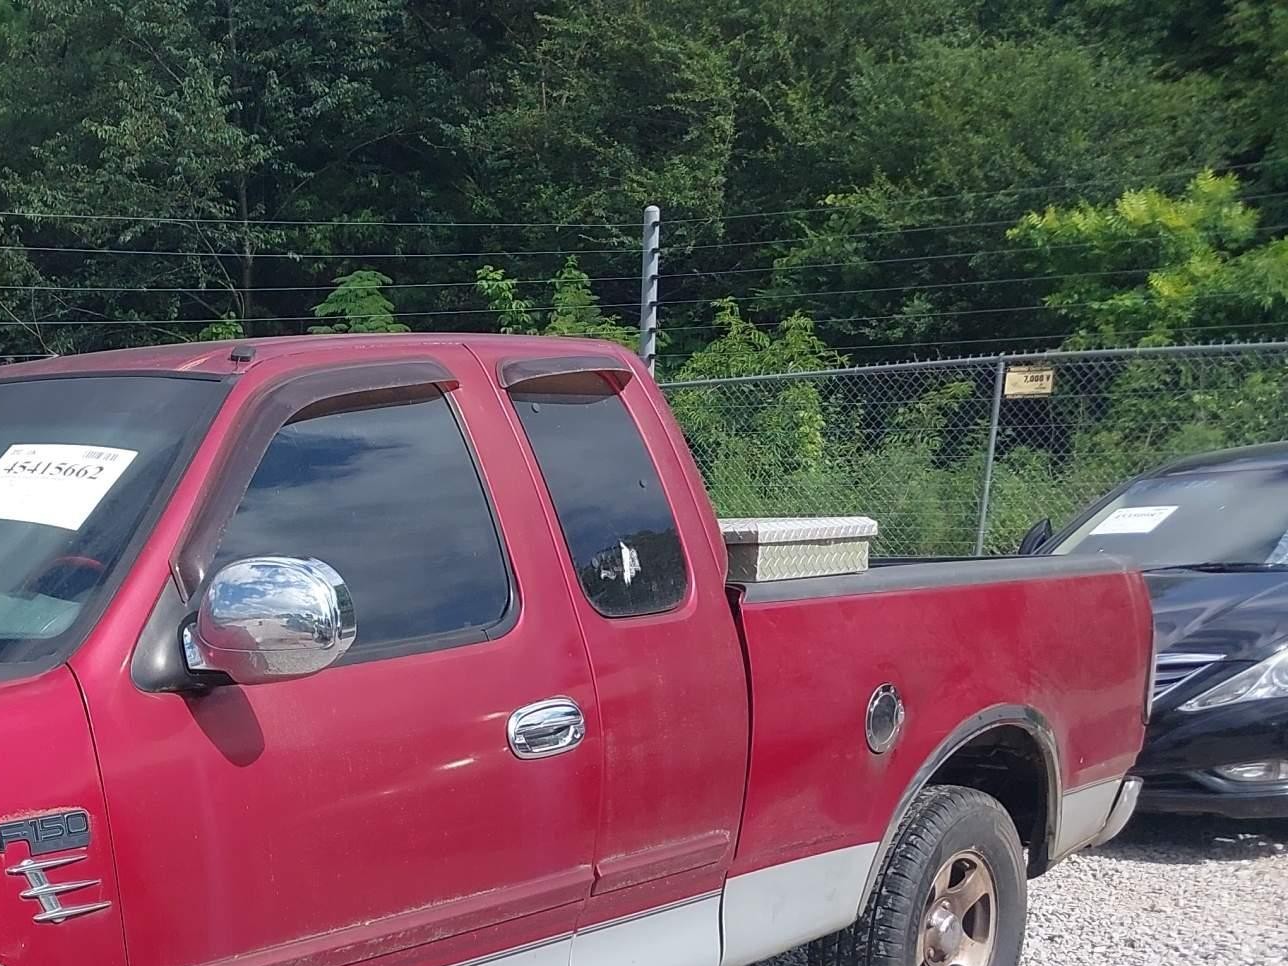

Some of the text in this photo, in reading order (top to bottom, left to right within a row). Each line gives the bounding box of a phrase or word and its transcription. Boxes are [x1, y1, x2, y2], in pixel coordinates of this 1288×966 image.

[1023, 374, 1051, 384] 7,000 V
[3, 460, 105, 480] 45415662
